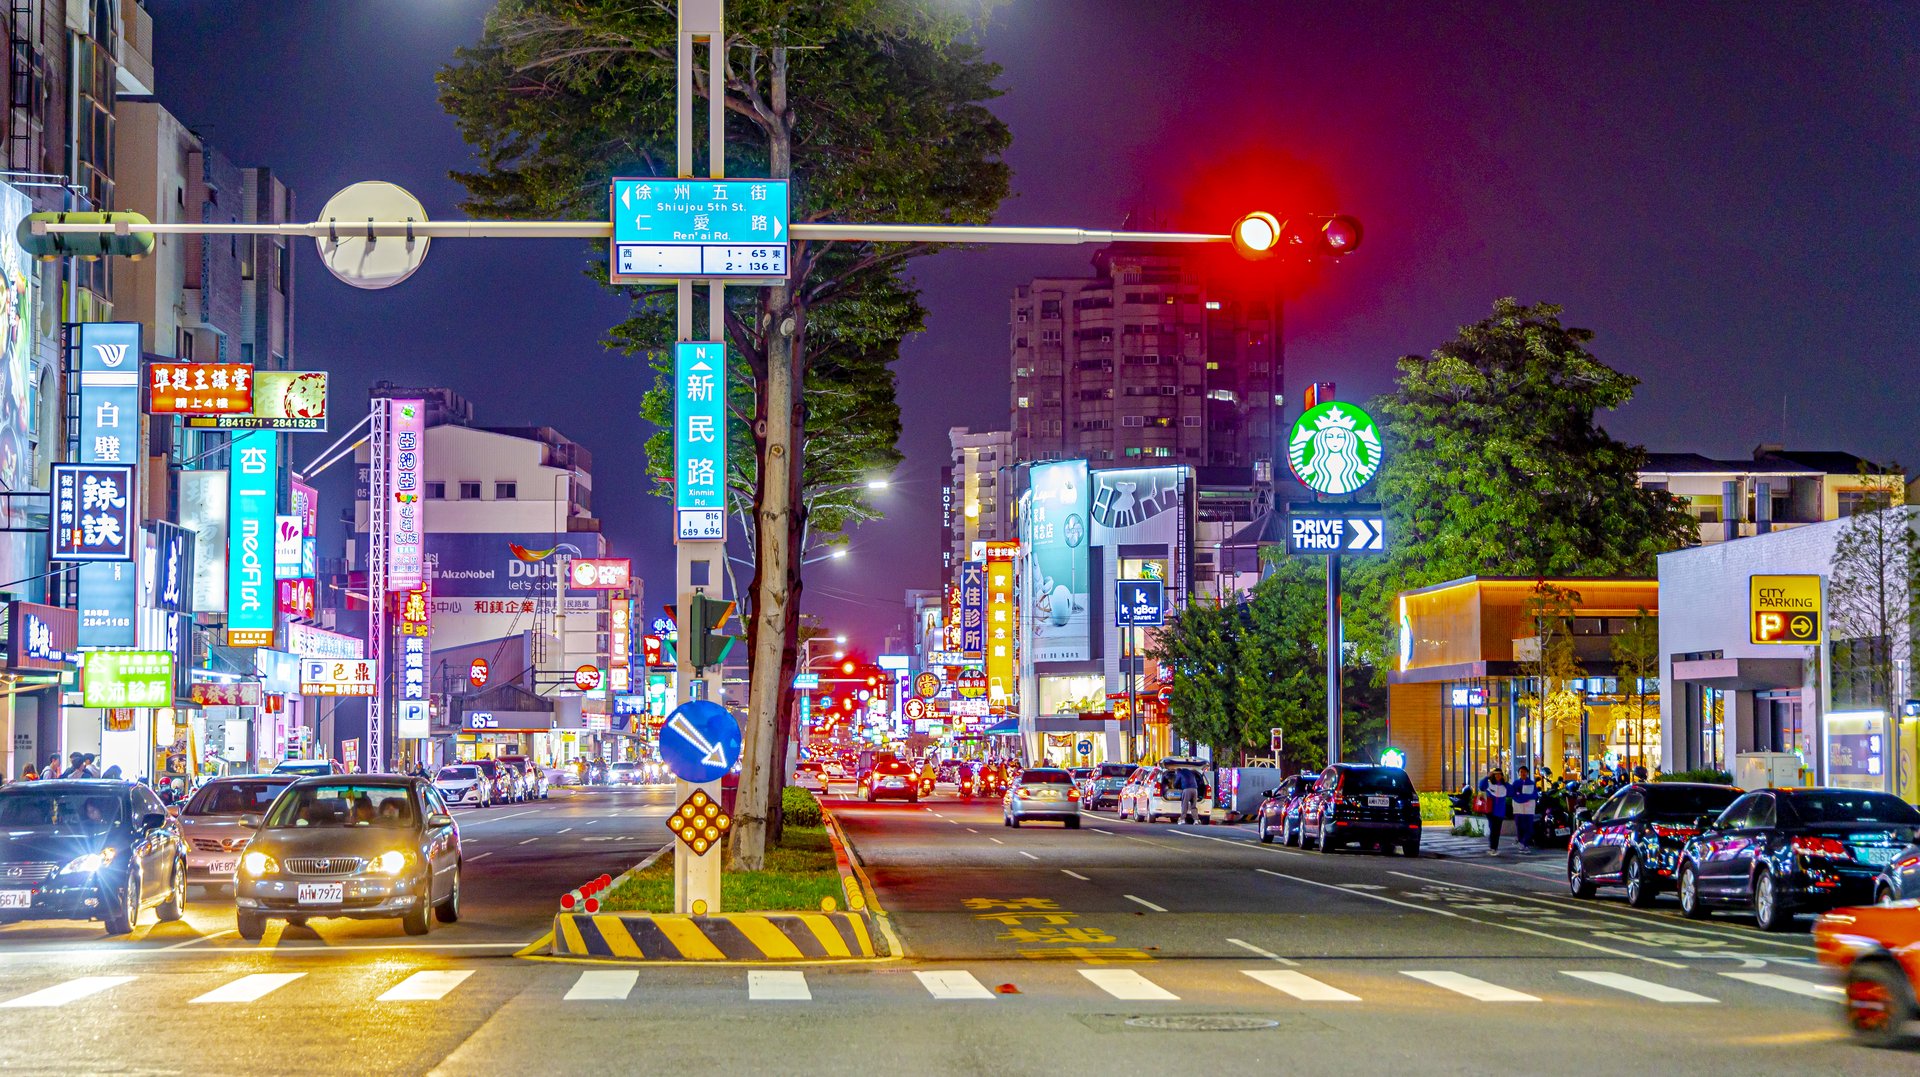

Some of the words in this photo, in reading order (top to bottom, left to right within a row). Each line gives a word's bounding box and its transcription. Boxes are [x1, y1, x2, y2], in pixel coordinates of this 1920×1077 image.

[635, 184, 767, 201] 徐州五街
[657, 203, 703, 214] Shiujou
[707, 203, 728, 212] 5th
[732, 203, 747, 212] St.
[635, 214, 767, 231] 仁愛路
[714, 231, 731, 241] Rd.
[623, 249, 632, 258] 西
[727, 250, 731, 258] 1
[751, 250, 767, 258] 65
[772, 250, 781, 259] 東
[725, 263, 733, 271] 2
[749, 262, 769, 271] 136
[219, 418, 263, 427] 2841571
[273, 418, 318, 428] 2841528
[687, 374, 715, 486] 新民路
[240, 447, 267, 496] 杏一
[395, 492, 418, 504] Toys
[688, 488, 714, 497] Xinmin
[82, 475, 126, 546] 辣訣
[705, 512, 719, 520] 816
[682, 528, 698, 536] 689
[704, 528, 721, 536] 696
[1292, 519, 1343, 535] DRIVE
[1293, 534, 1341, 549] THRU
[441, 570, 495, 579] AkzoNobel
[508, 580, 532, 591] let's
[1759, 588, 1785, 598] CITY
[964, 565, 982, 650] 大佳診所
[1759, 597, 1813, 608] PARKING
[403, 622, 428, 636] 日式
[1760, 613, 1781, 640] P
[310, 664, 324, 680] P
[333, 662, 370, 681] 色鼎
[919, 674, 937, 696] 當
[408, 706, 420, 719] P
[960, 897, 1159, 965] 禁行機車
